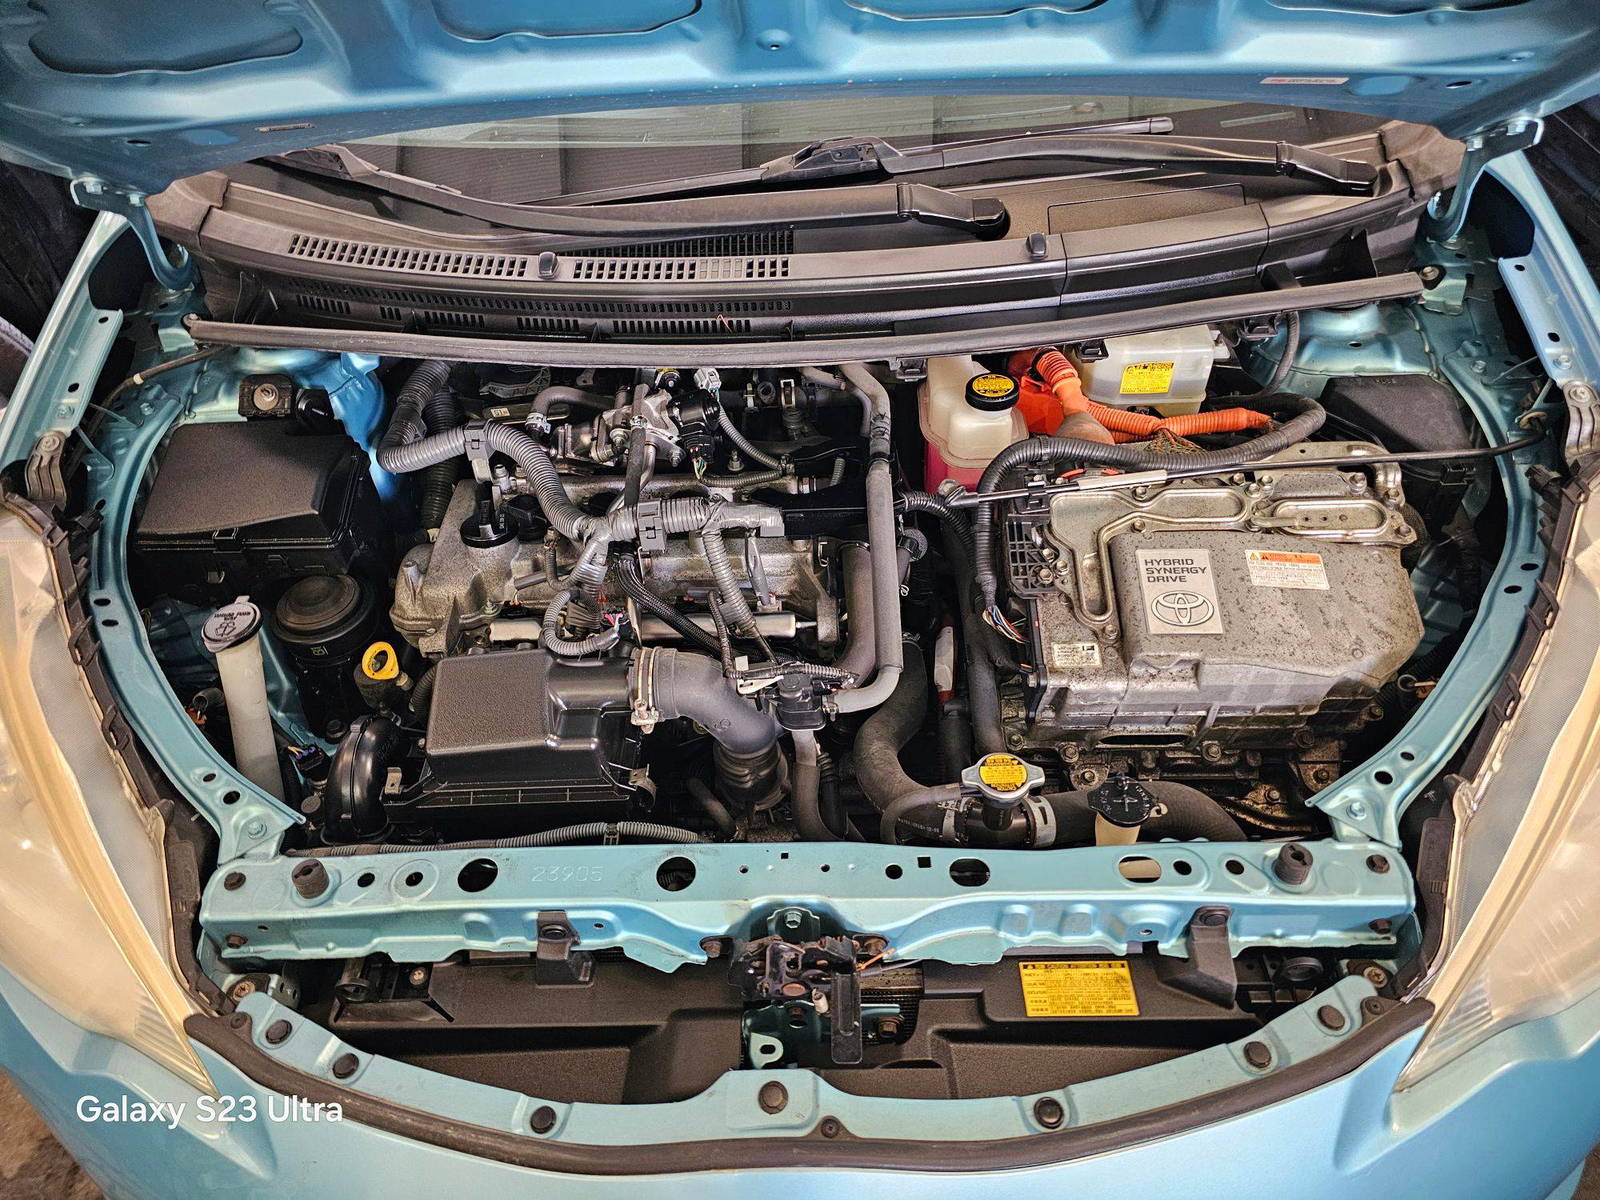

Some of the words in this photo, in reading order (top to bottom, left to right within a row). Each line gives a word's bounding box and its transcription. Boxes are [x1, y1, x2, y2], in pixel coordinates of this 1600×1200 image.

[1144, 558, 1194, 566] HYBRID
[1145, 566, 1207, 575] SYNERGY
[1147, 575, 1187, 583] DRIVE
